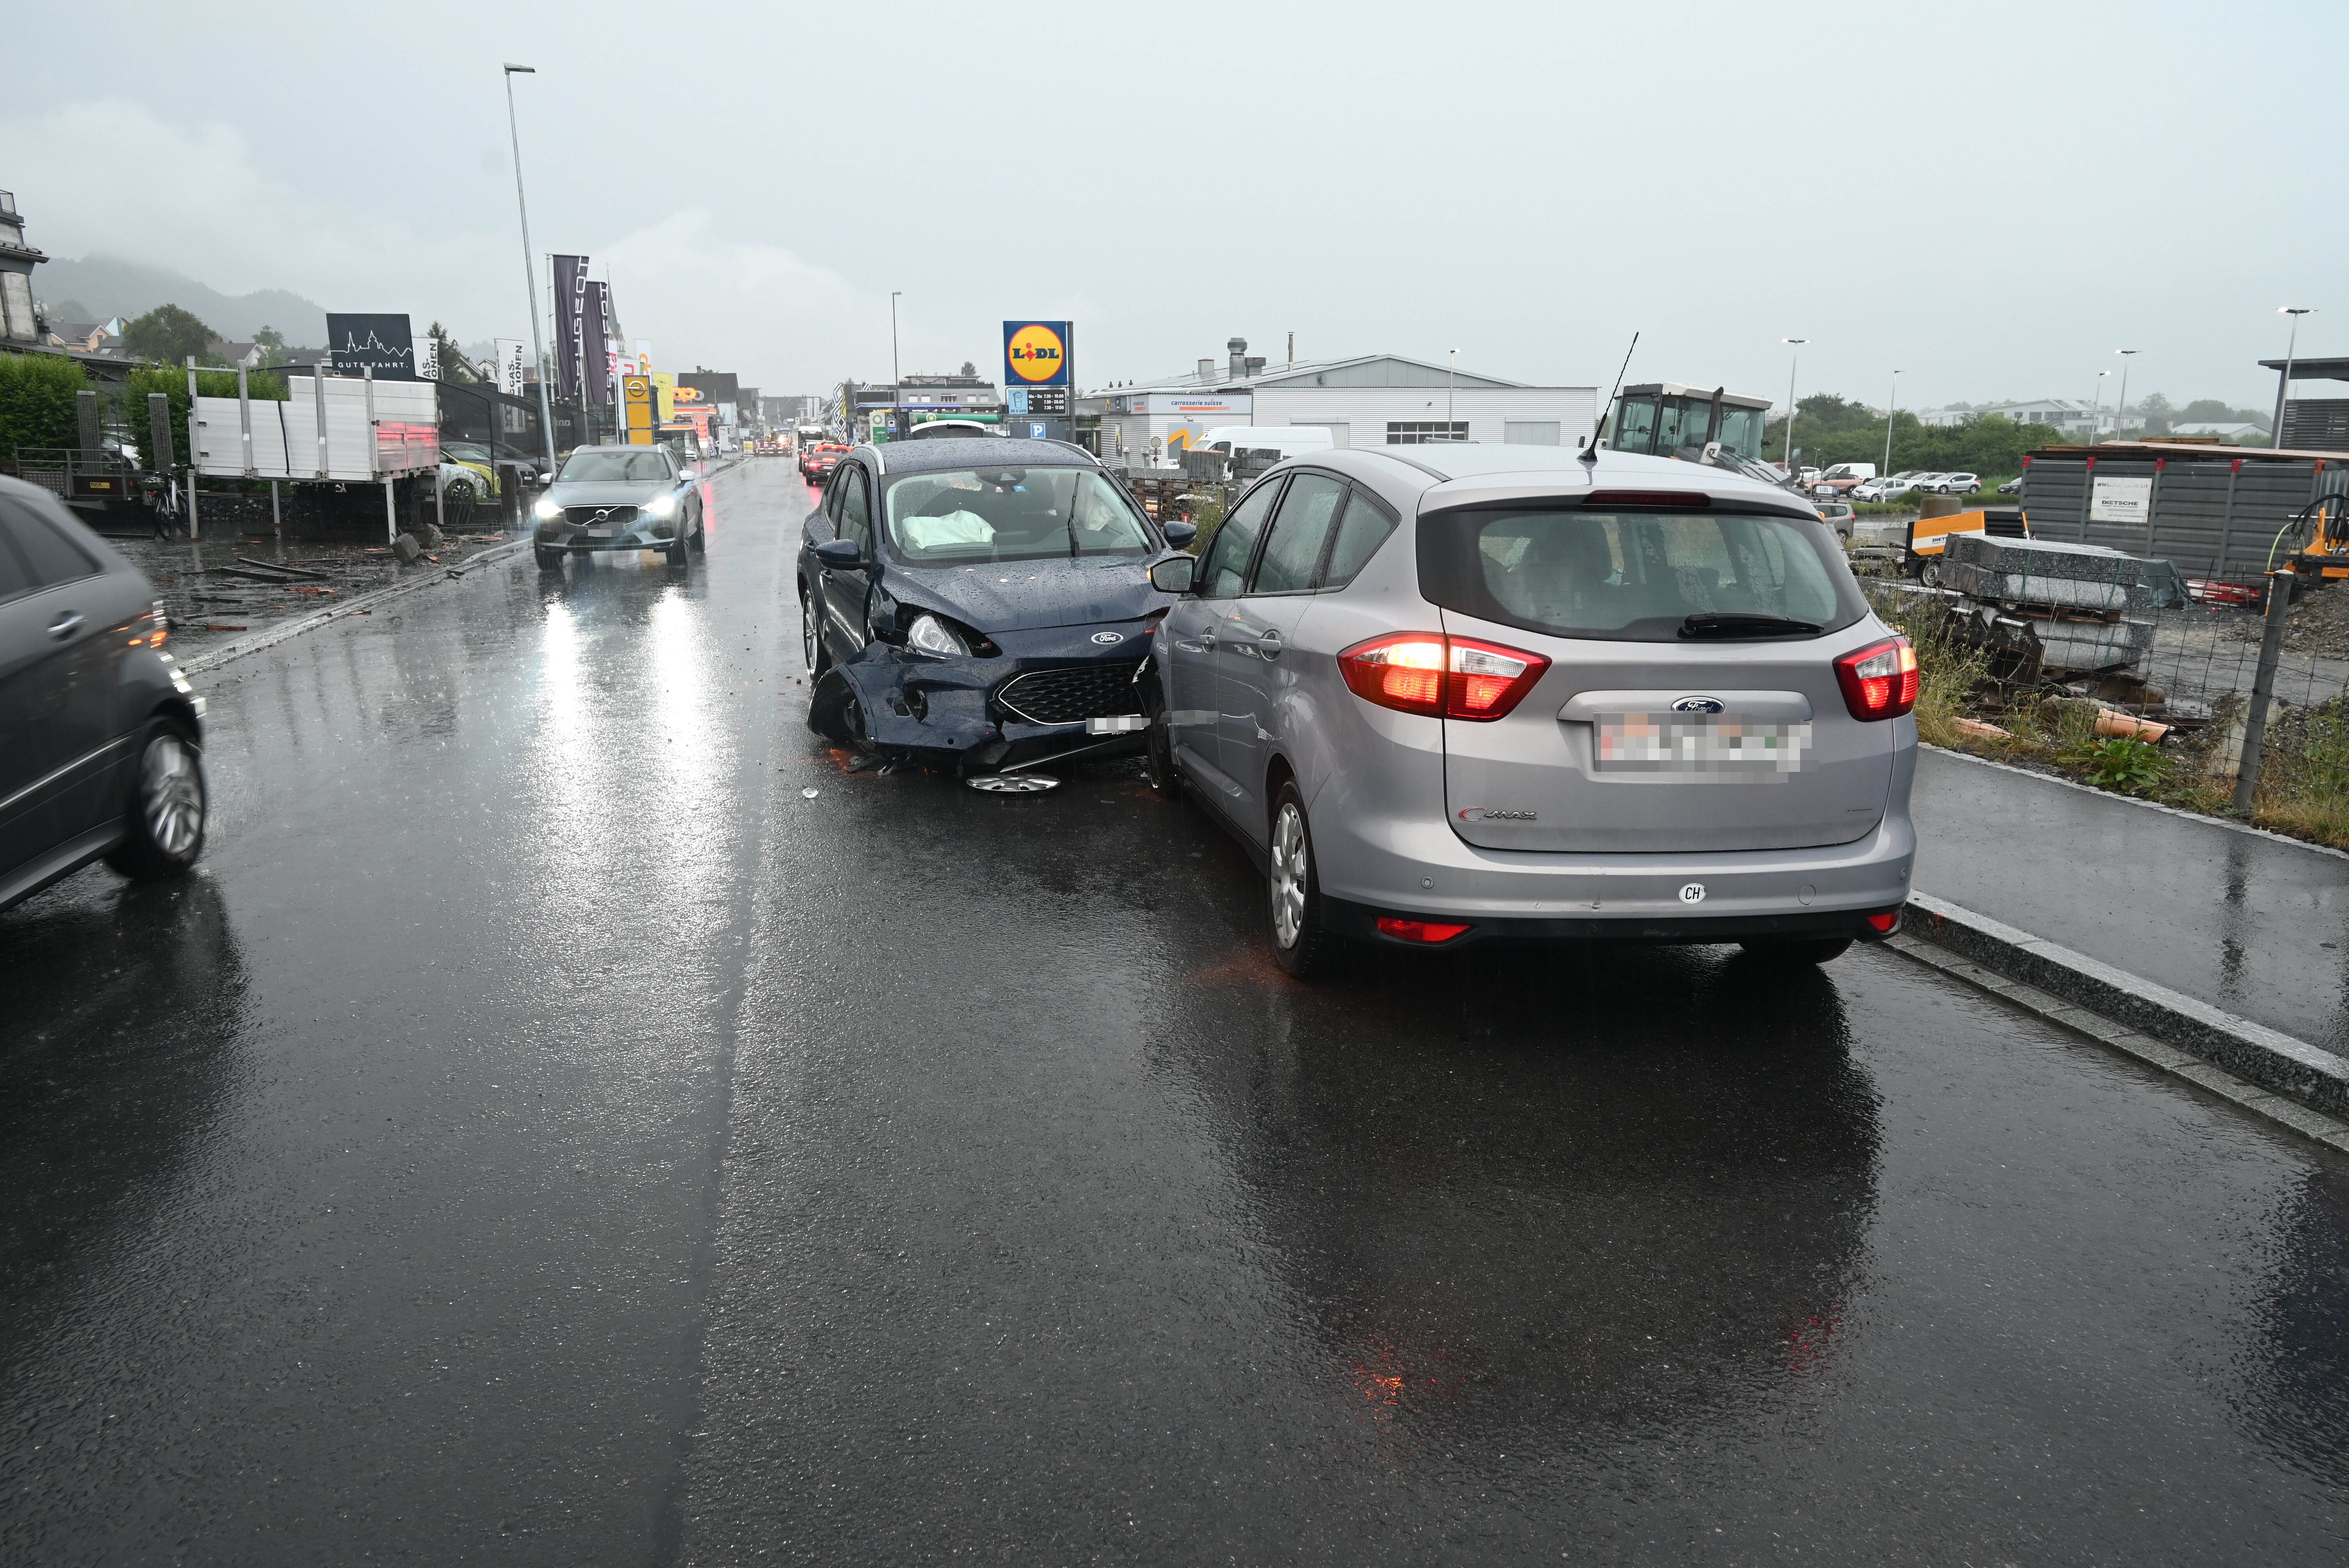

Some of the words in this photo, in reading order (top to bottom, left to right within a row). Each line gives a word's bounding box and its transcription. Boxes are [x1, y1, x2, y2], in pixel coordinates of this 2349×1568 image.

[1033, 425, 1043, 436] P
[1685, 701, 1714, 711] Ford
[1685, 887, 1700, 900] CH
